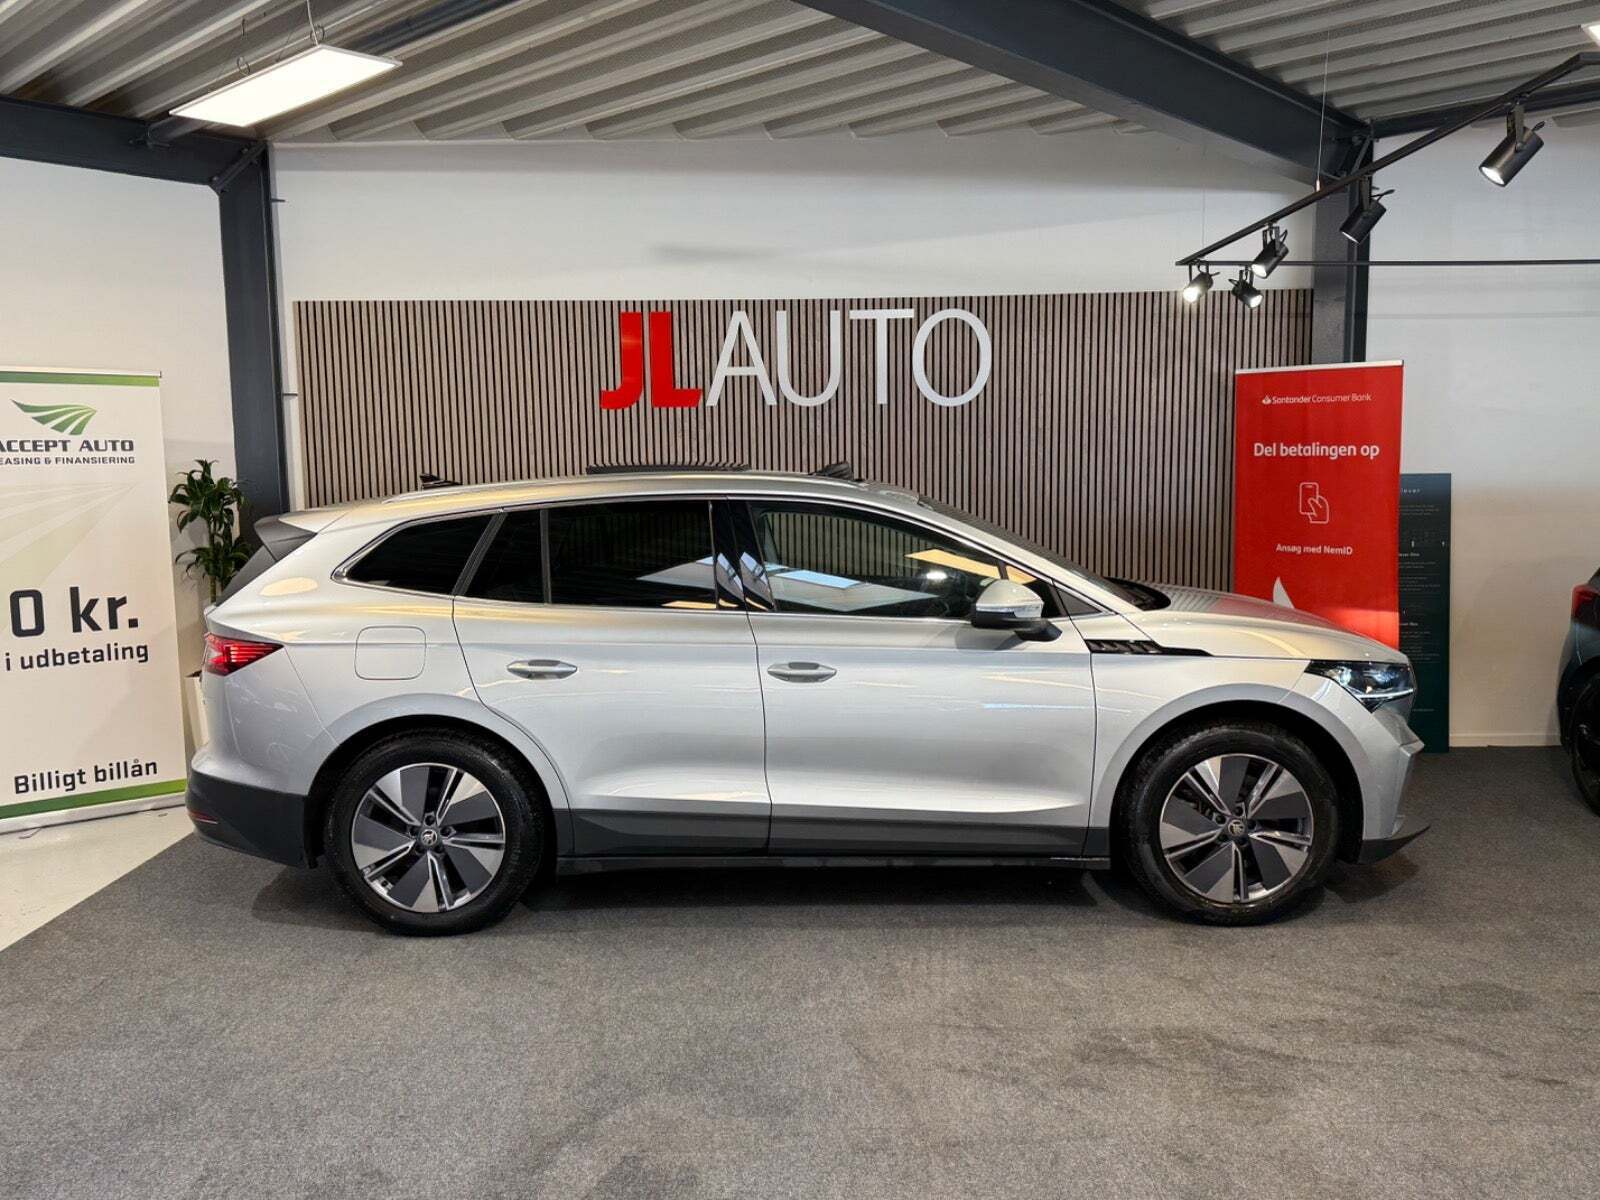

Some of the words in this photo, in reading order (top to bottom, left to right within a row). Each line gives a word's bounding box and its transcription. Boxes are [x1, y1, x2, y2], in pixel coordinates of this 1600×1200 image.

[1272, 395, 1310, 404] Santander
[1312, 394, 1351, 403] Consumer
[1351, 392, 1372, 402] Bank
[79, 439, 135, 452] AUTO
[1254, 442, 1277, 457] Del
[1280, 441, 1357, 460] betalingen
[1360, 445, 1380, 460] op
[0, 457, 41, 466] EASING
[44, 457, 52, 465] &
[55, 455, 136, 465] FINANSIERING
[1276, 543, 1302, 555] Ansøg
[1303, 545, 1322, 554] med
[1323, 545, 1353, 555] NemID
[9, 589, 45, 638] 0
[69, 586, 139, 633] kr.
[5, 652, 11, 671] i
[20, 642, 149, 670] udbetaling
[14, 768, 87, 795] Billigt
[94, 758, 158, 783] billån
